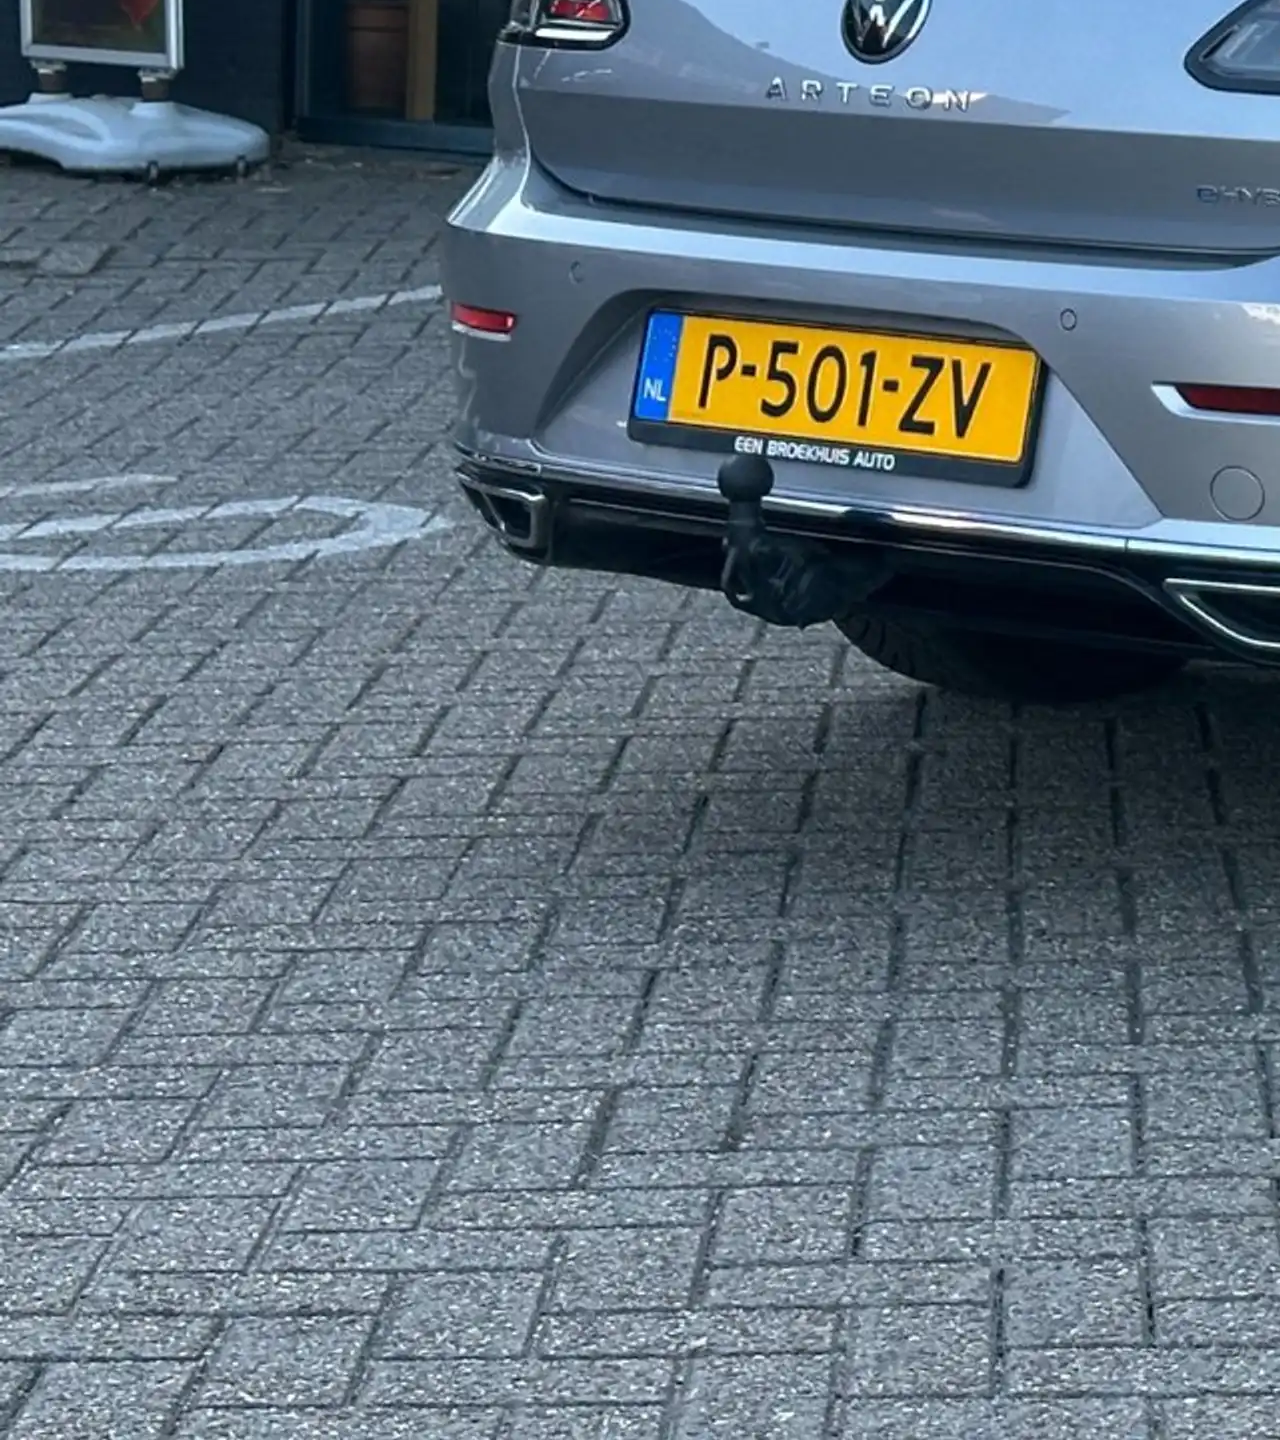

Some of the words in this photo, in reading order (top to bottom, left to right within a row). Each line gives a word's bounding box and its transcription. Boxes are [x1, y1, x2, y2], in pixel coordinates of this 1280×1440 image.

[766, 76, 971, 112] ARTEON
[643, 378, 667, 402] NL
[698, 332, 992, 439] P-501-ZV
[734, 436, 763, 455] EEN
[766, 440, 850, 465] BROEKHUIS
[852, 451, 896, 471] AUTO
